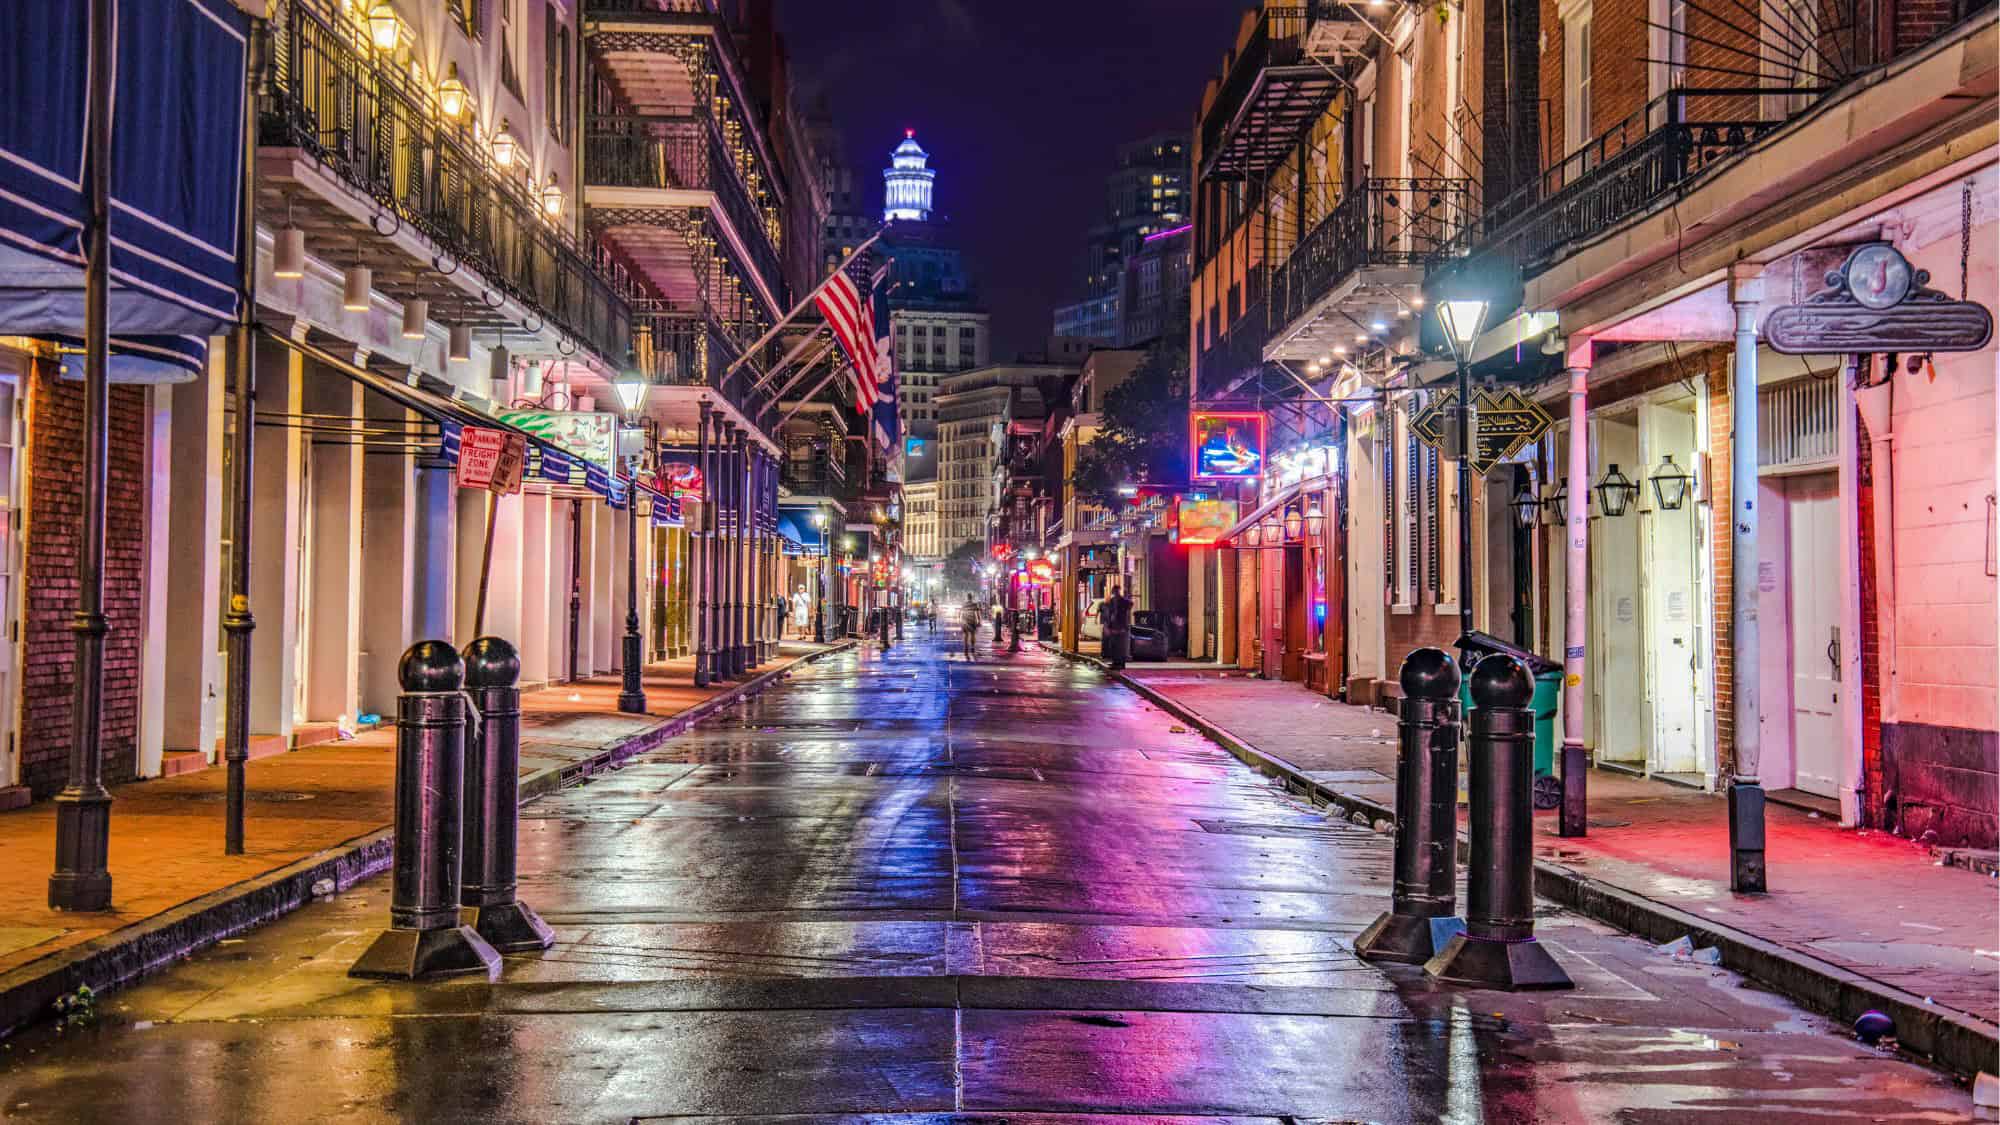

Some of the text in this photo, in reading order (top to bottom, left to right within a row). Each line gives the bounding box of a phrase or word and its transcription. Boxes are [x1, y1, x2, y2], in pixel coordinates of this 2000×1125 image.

[463, 431, 500, 445] NO PARKING
[463, 448, 497, 460] FREIGHT
[467, 458, 489, 469] ZONE
